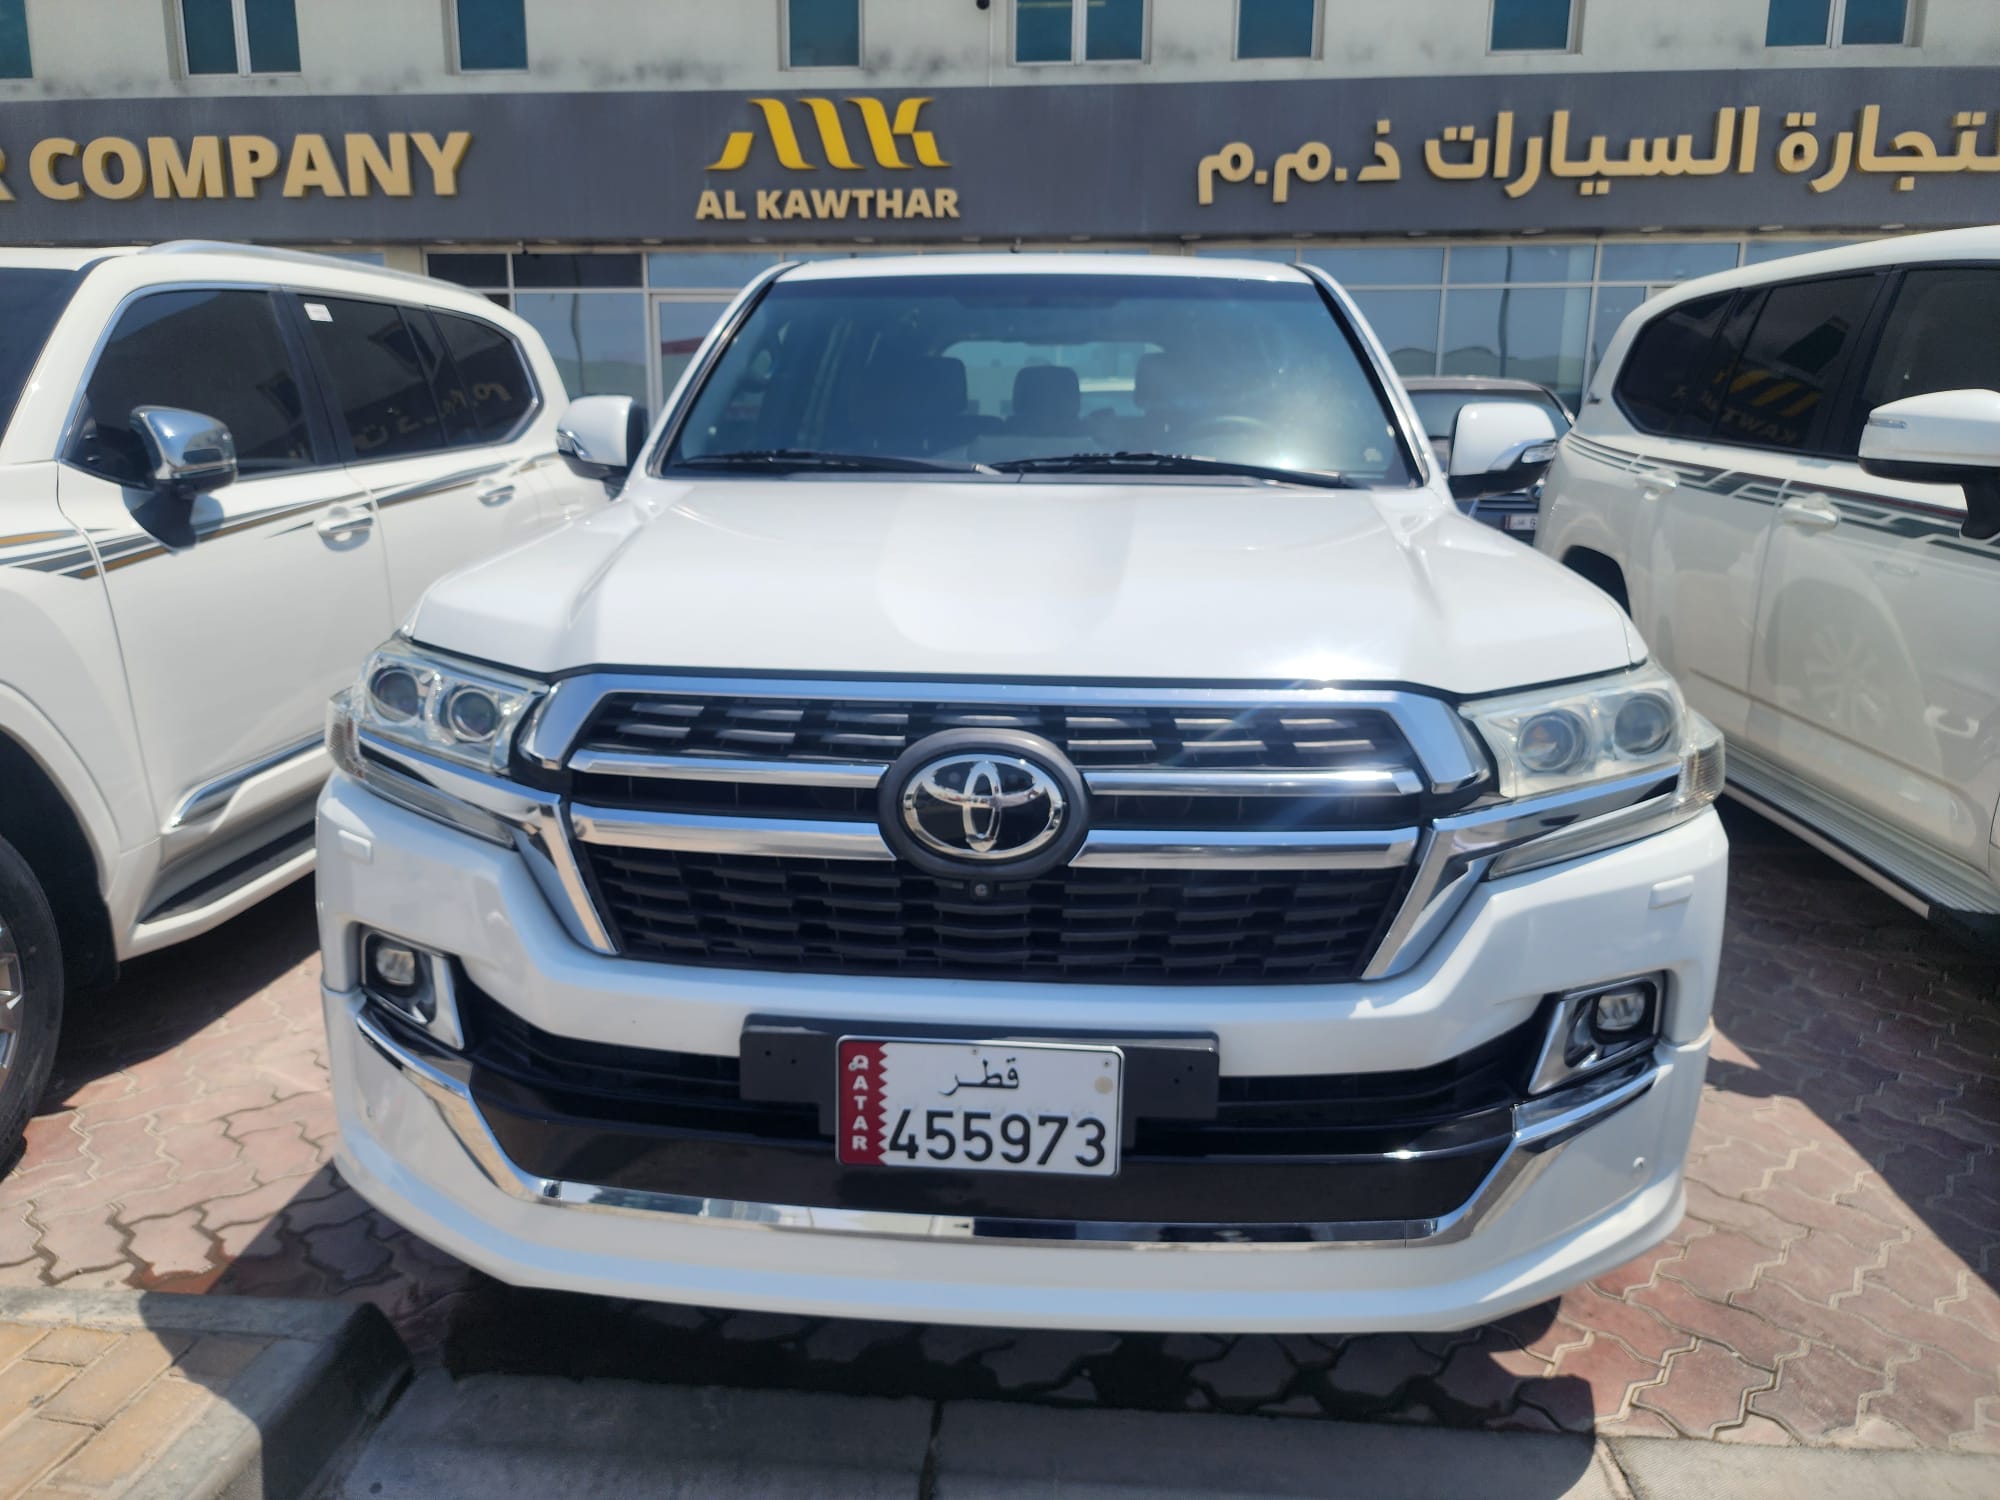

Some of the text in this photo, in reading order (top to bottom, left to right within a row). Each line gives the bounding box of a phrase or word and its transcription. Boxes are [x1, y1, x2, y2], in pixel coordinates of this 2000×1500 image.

[29, 131, 472, 200] COMPANY
[1423, 105, 1761, 199] السيارات
[1776, 103, 2000, 194] تجارة
[695, 187, 961, 220] AL KAWTHAR
[848, 1054, 870, 1151] QATAR
[937, 1056, 1021, 1097] قطر
[887, 1107, 1107, 1168] 455973
